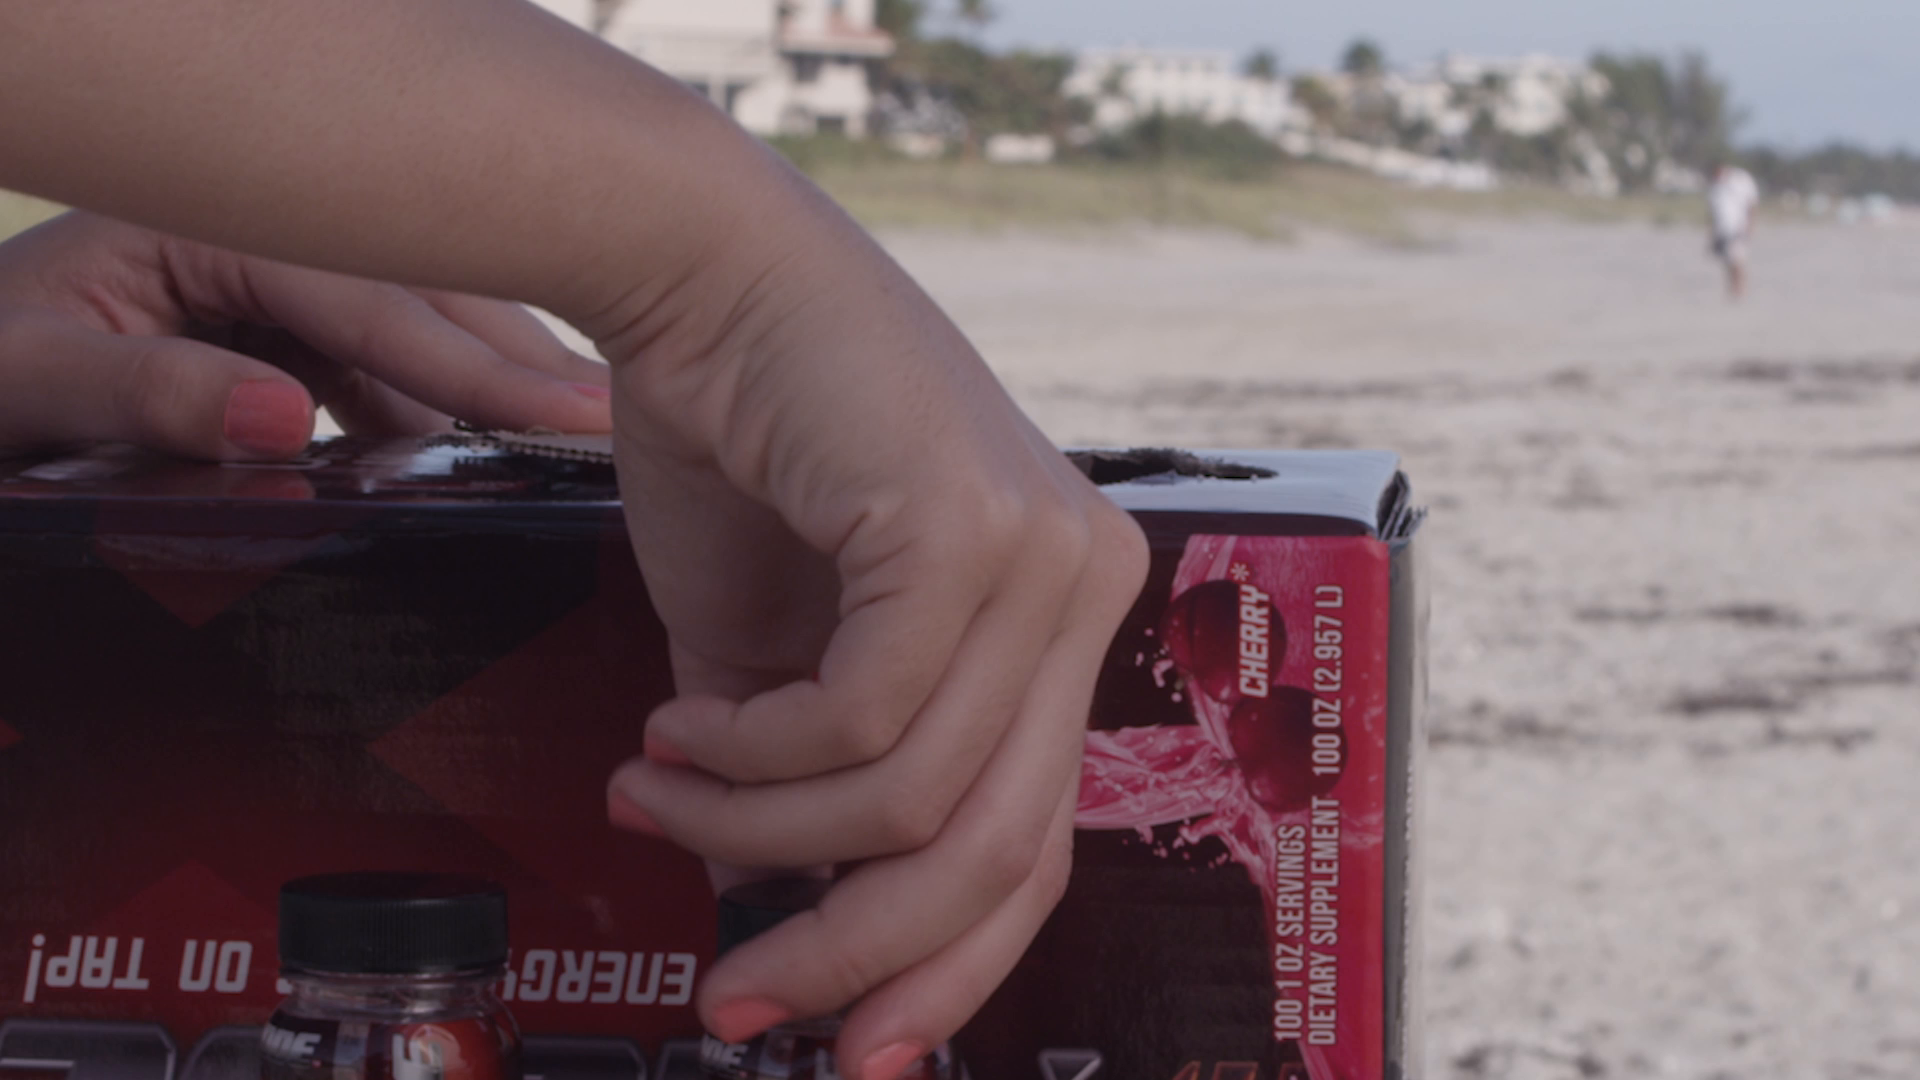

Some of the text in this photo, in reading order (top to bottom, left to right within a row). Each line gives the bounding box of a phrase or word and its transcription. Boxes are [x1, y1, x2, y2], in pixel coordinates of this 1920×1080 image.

[1307, 585, 1344, 1046] DIETARY SUPPLEMENT 100 OZ (2.957 L)
[23, 933, 150, 1003] TAP!
[178, 939, 254, 994] ON
[1274, 825, 1307, 1041] 100 1 OZ SERVINGS
